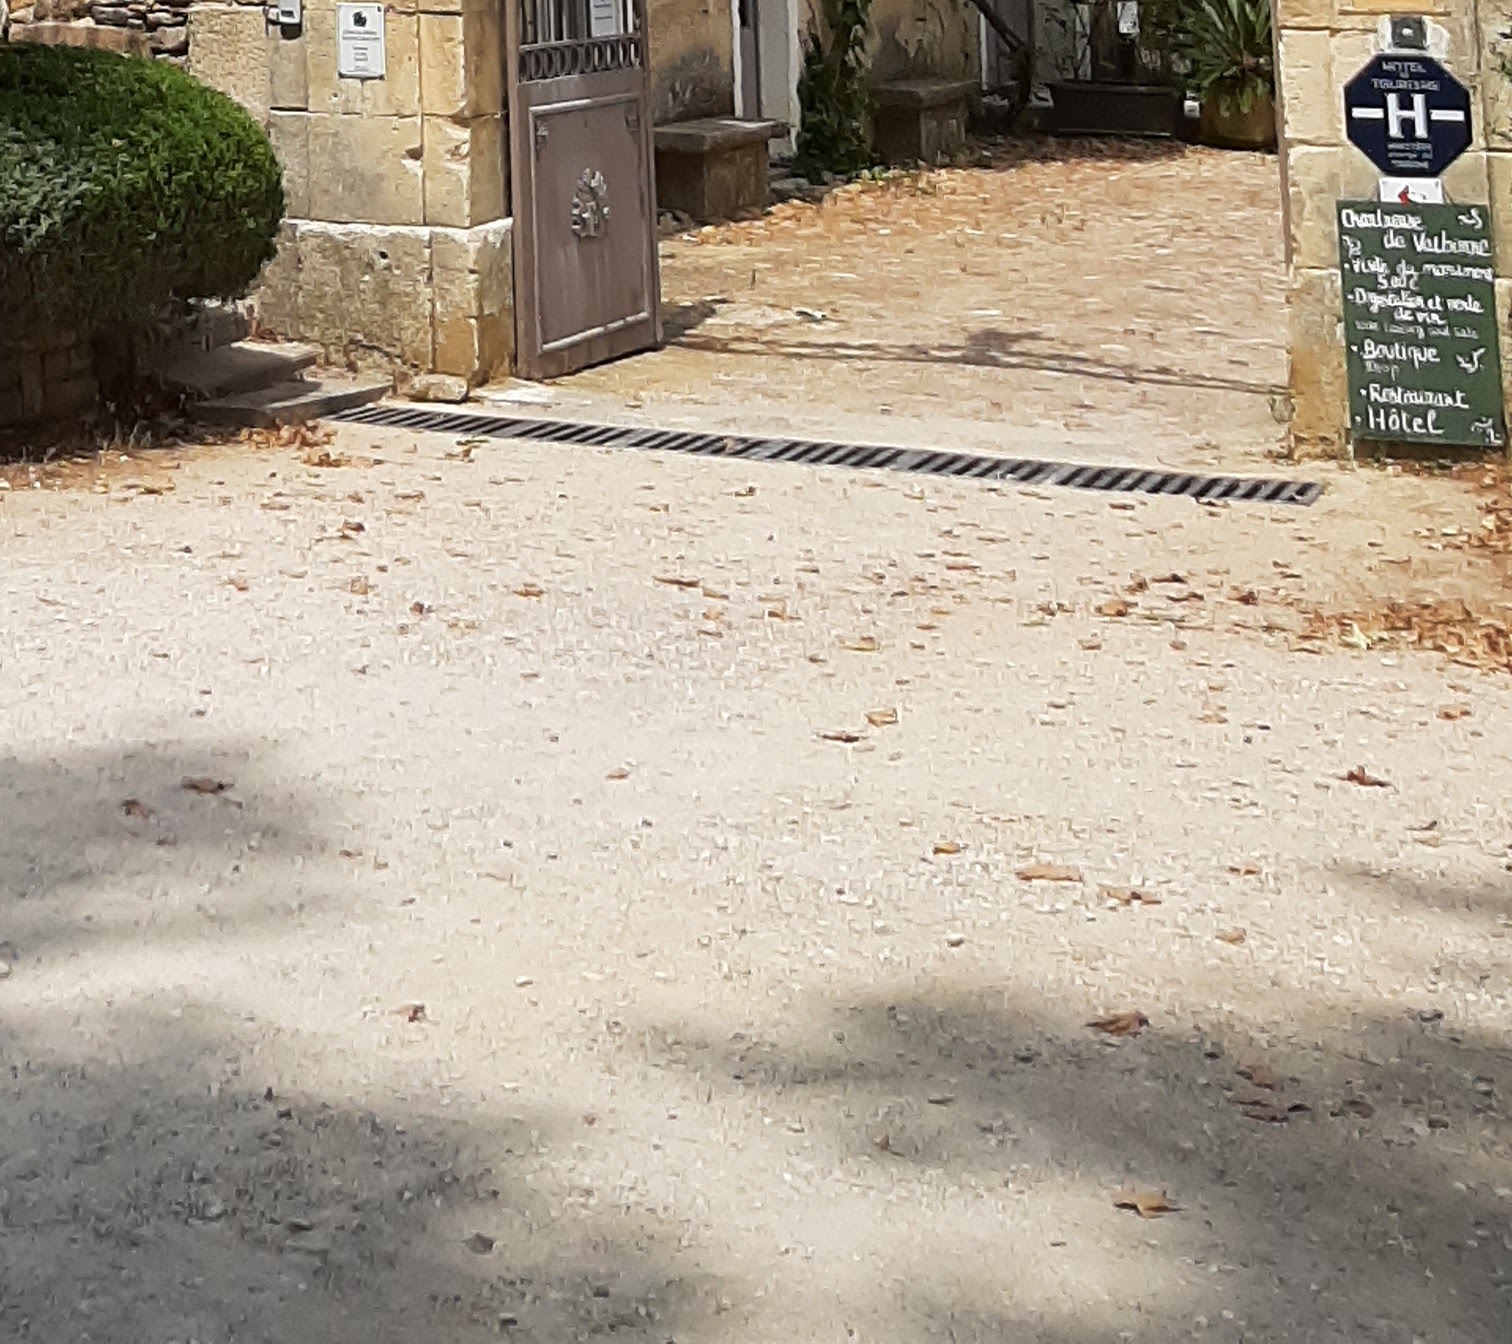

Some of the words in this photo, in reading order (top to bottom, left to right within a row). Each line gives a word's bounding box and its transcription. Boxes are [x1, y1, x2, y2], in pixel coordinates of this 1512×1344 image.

[1385, 92, 1429, 139] H
[1383, 229, 1406, 249] de
[1363, 338, 1440, 370] Boutique
[1367, 405, 1444, 434] Hôtel
